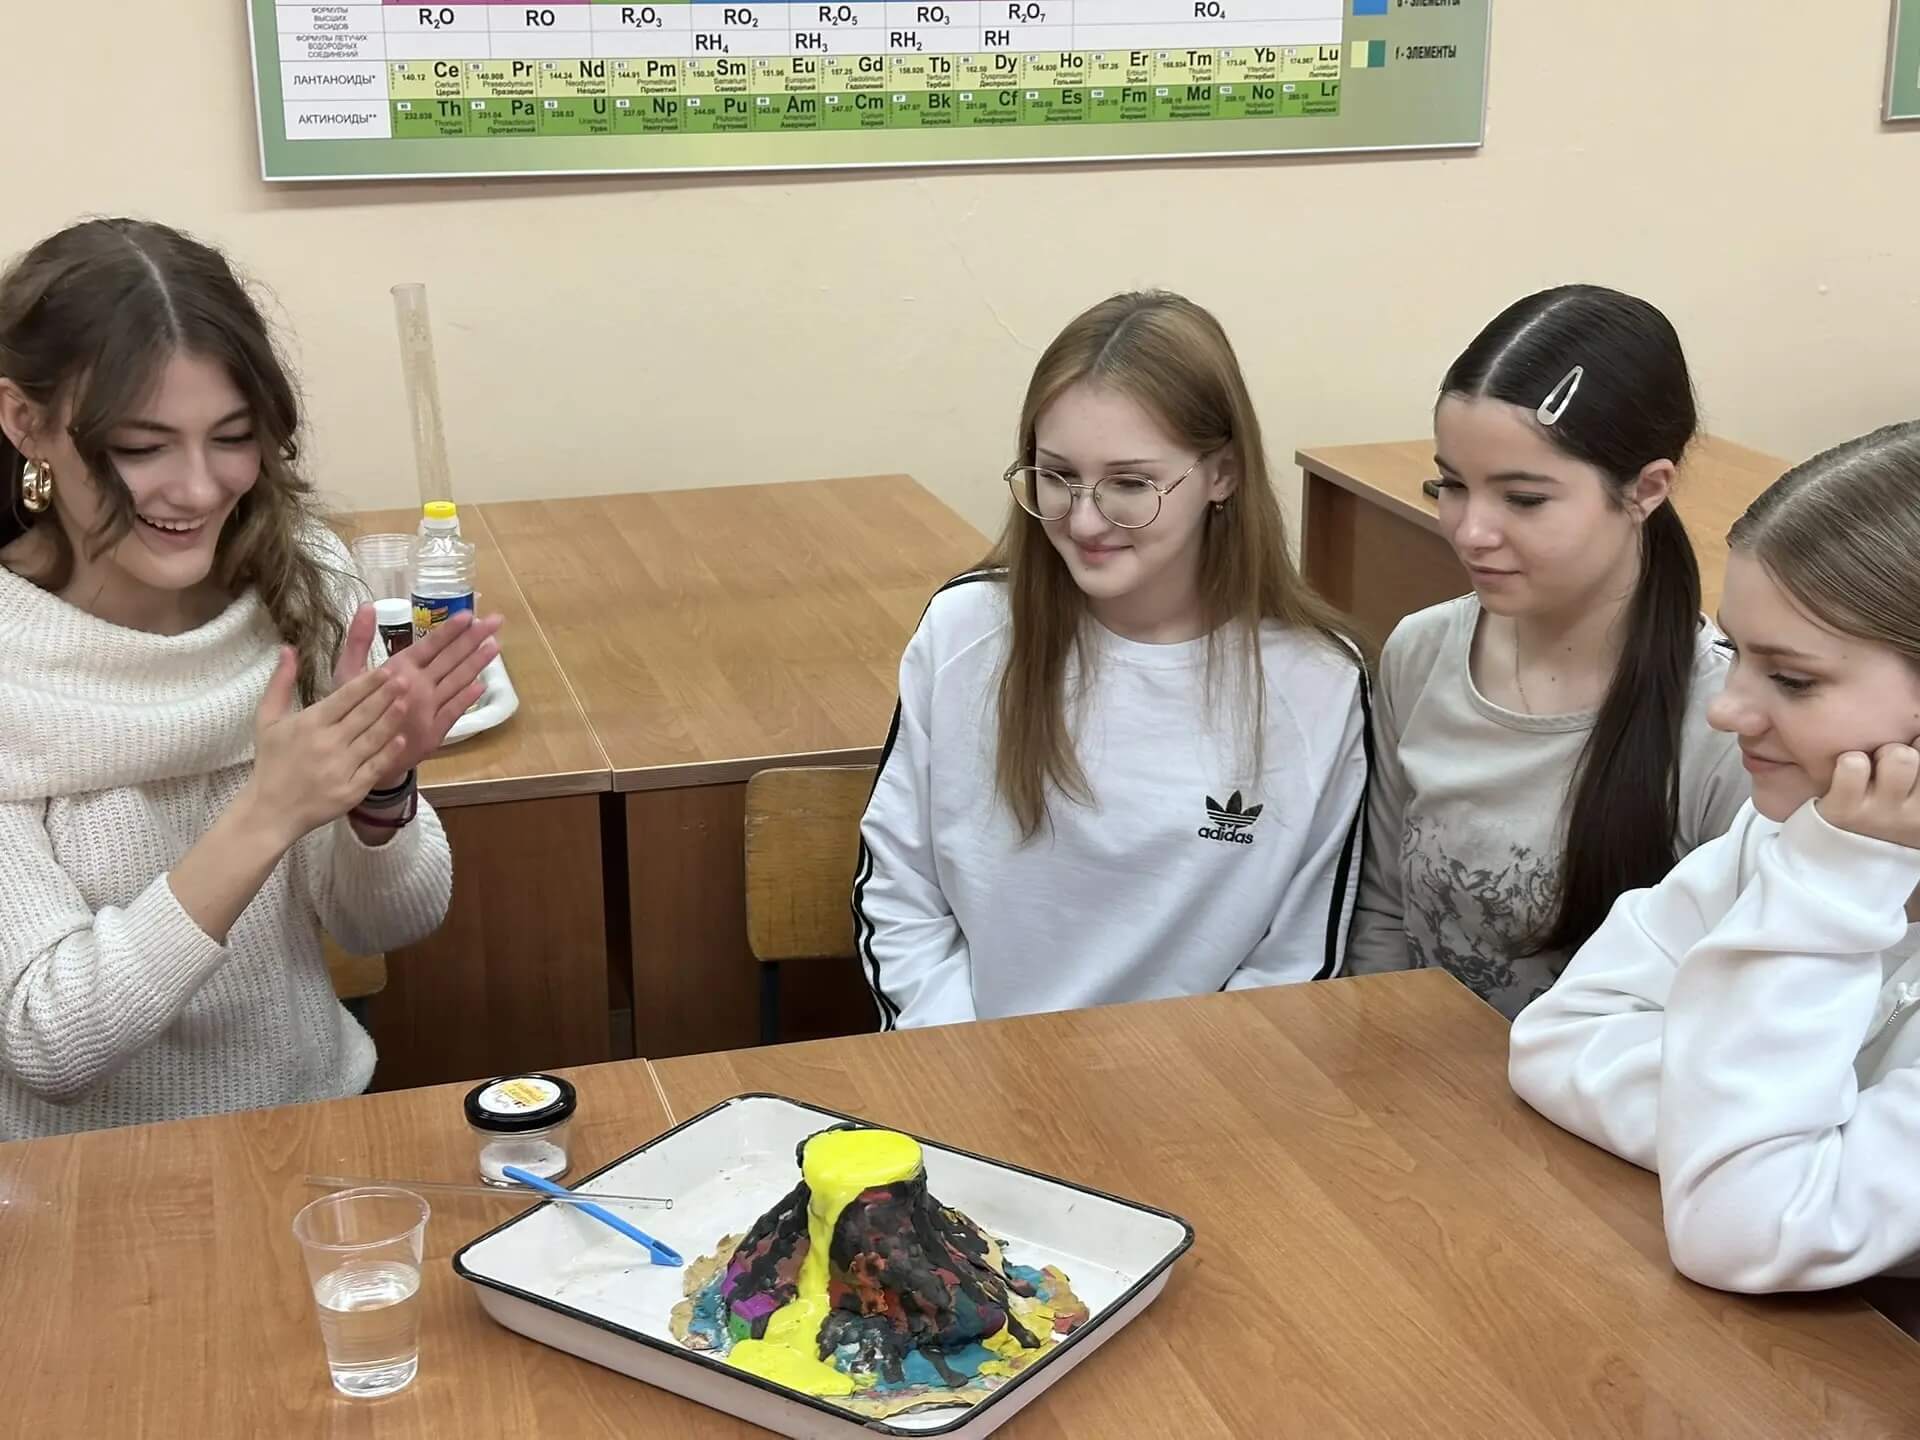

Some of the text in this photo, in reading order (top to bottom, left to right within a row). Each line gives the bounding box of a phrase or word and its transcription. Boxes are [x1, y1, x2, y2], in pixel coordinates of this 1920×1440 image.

[526, 10, 555, 26] RO
[985, 31, 1010, 46] RH
[1131, 52, 1148, 66] Er
[1186, 52, 1211, 66] Tm
[1255, 48, 1275, 63] Yb
[1319, 47, 1338, 61] Lu
[1406, 46, 1456, 59] ЭЛЕМЕНТЫ
[717, 60, 746, 76] Sm
[793, 58, 815, 73] Eu
[859, 57, 883, 72] Gd
[930, 57, 950, 73] Tb
[995, 55, 1017, 72] Dy
[1061, 54, 1083, 68] Ho
[434, 62, 459, 77] Ce
[513, 61, 533, 77] Pr
[580, 61, 604, 77] Nd
[647, 61, 676, 77] Pm
[1062, 90, 1082, 104] Es
[1123, 88, 1147, 103] Fm
[1187, 87, 1210, 101] Md
[1253, 86, 1274, 100] No
[1321, 83, 1338, 96] Lr
[724, 98, 747, 113] Pu
[787, 96, 815, 113] Am
[855, 95, 883, 109] Cm
[929, 94, 950, 109] Bk
[999, 91, 1018, 106] Cf
[438, 101, 461, 116] Th
[512, 101, 534, 116] Pa
[594, 99, 606, 114] U
[653, 99, 678, 116] Np
[1198, 827, 1254, 844] adidas
